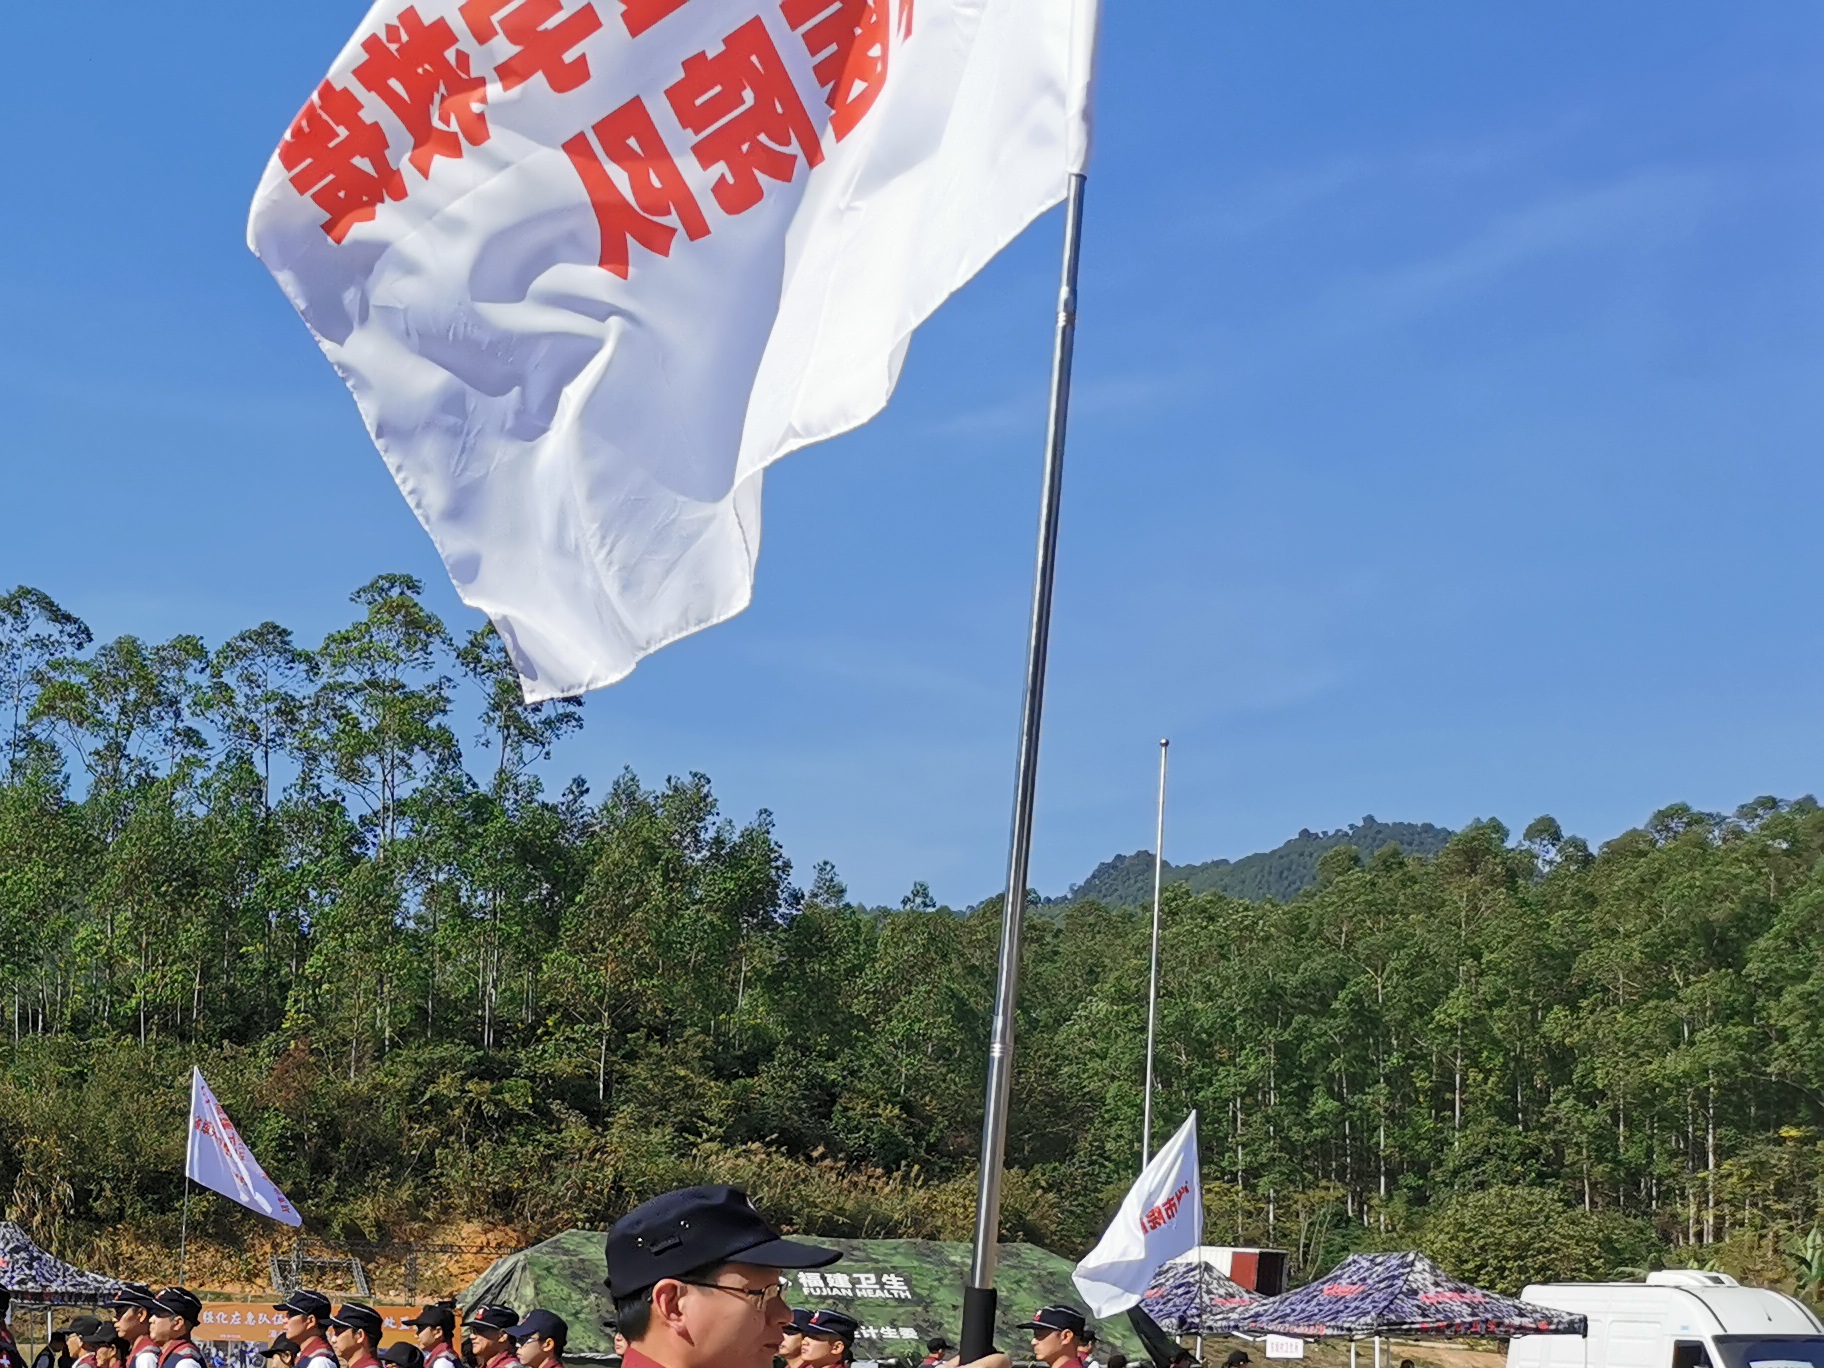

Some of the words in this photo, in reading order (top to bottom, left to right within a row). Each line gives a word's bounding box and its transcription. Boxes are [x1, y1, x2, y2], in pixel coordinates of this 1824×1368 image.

[797, 1271, 908, 1290] 福建卫生
[802, 1287, 853, 1297] FUJIAN
[855, 1288, 912, 1299] HEALTH
